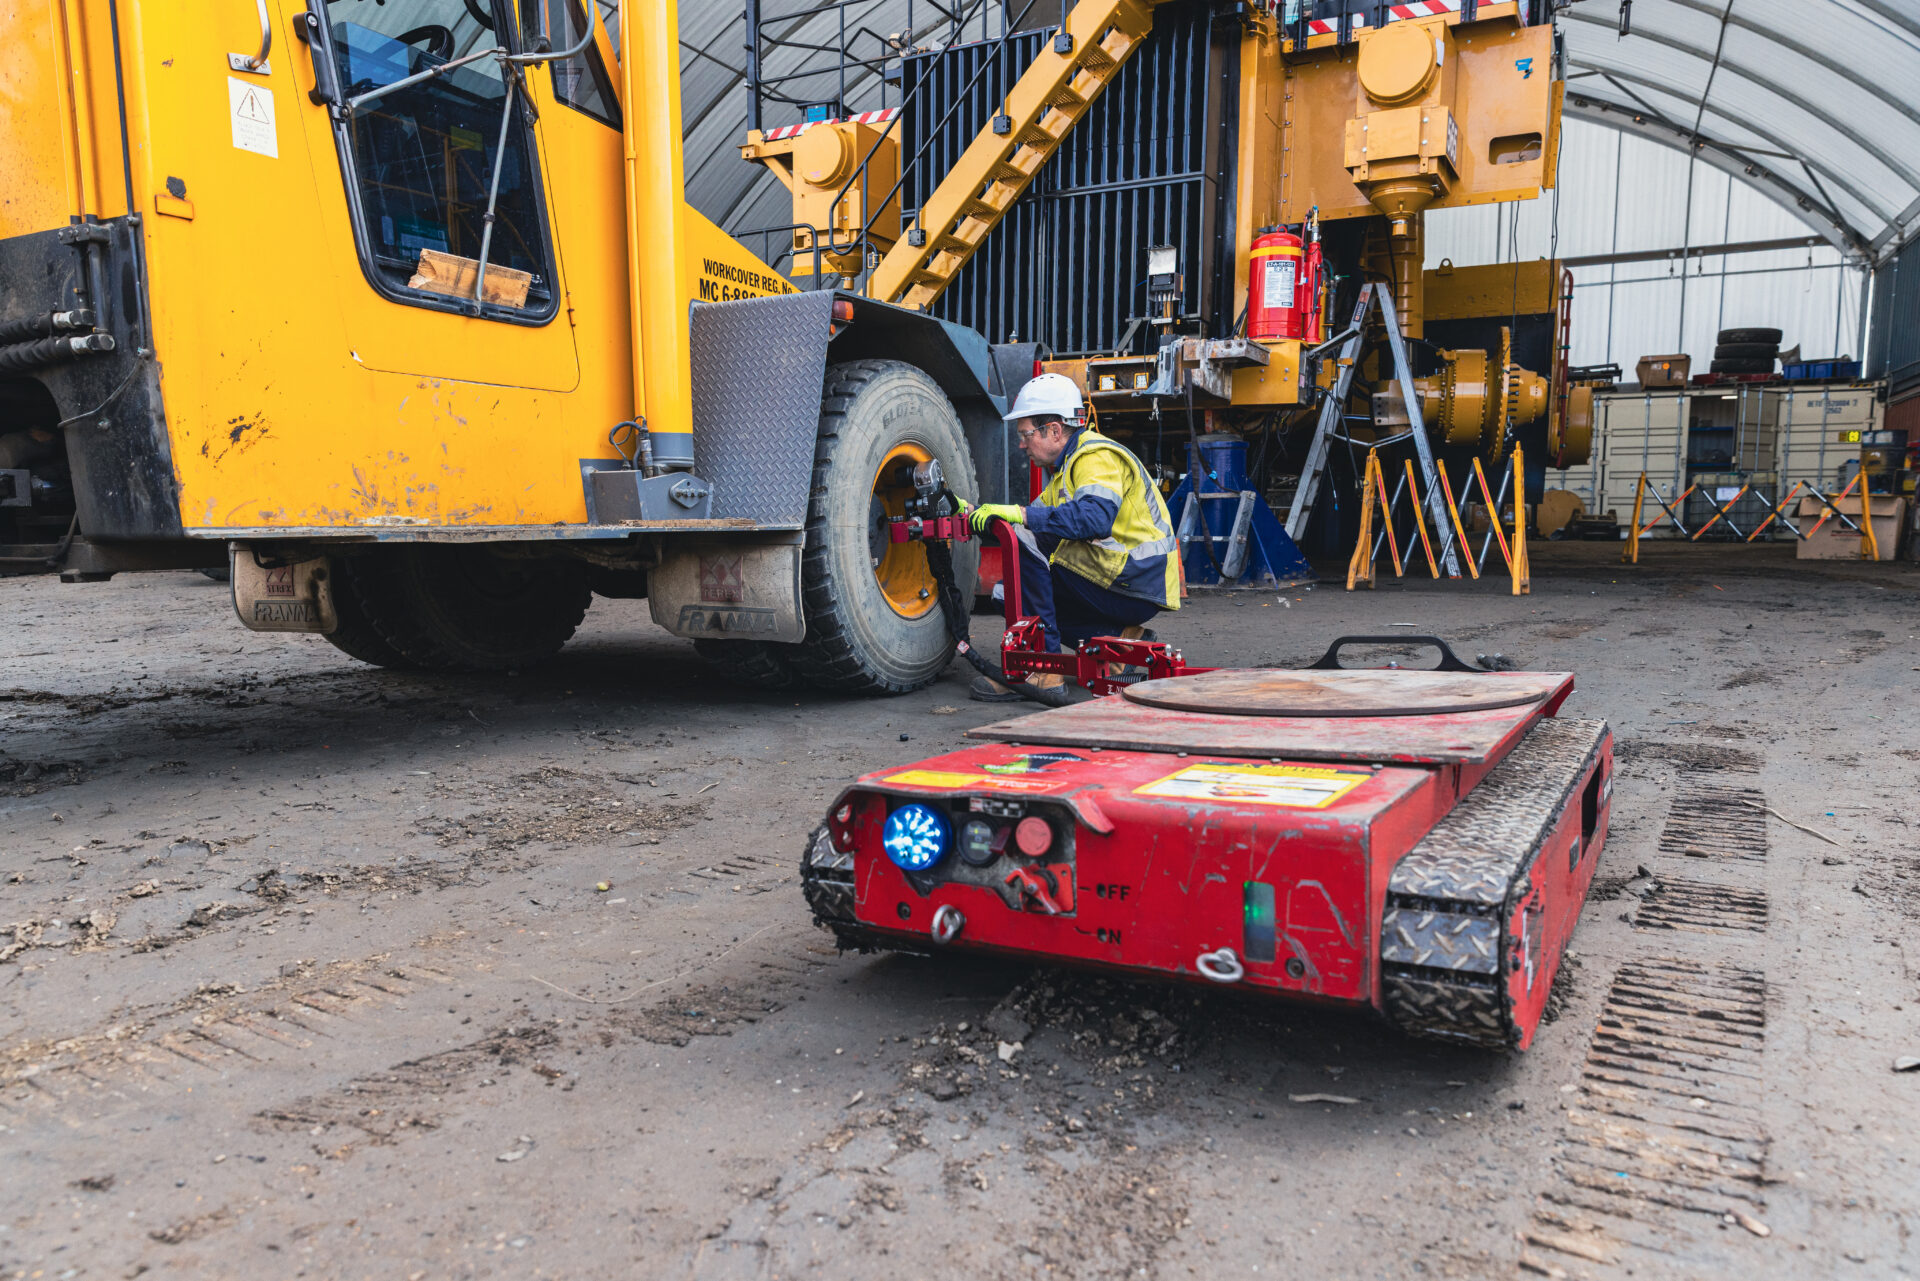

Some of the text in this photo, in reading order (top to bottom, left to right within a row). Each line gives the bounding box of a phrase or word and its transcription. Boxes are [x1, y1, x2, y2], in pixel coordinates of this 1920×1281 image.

[703, 257, 760, 289] WORKCOVER
[761, 275, 781, 295] REG.
[699, 278, 719, 302] MC
[703, 587, 741, 600] TEREX
[1096, 883, 1131, 902] OFF
[1096, 927, 1122, 945] ON
